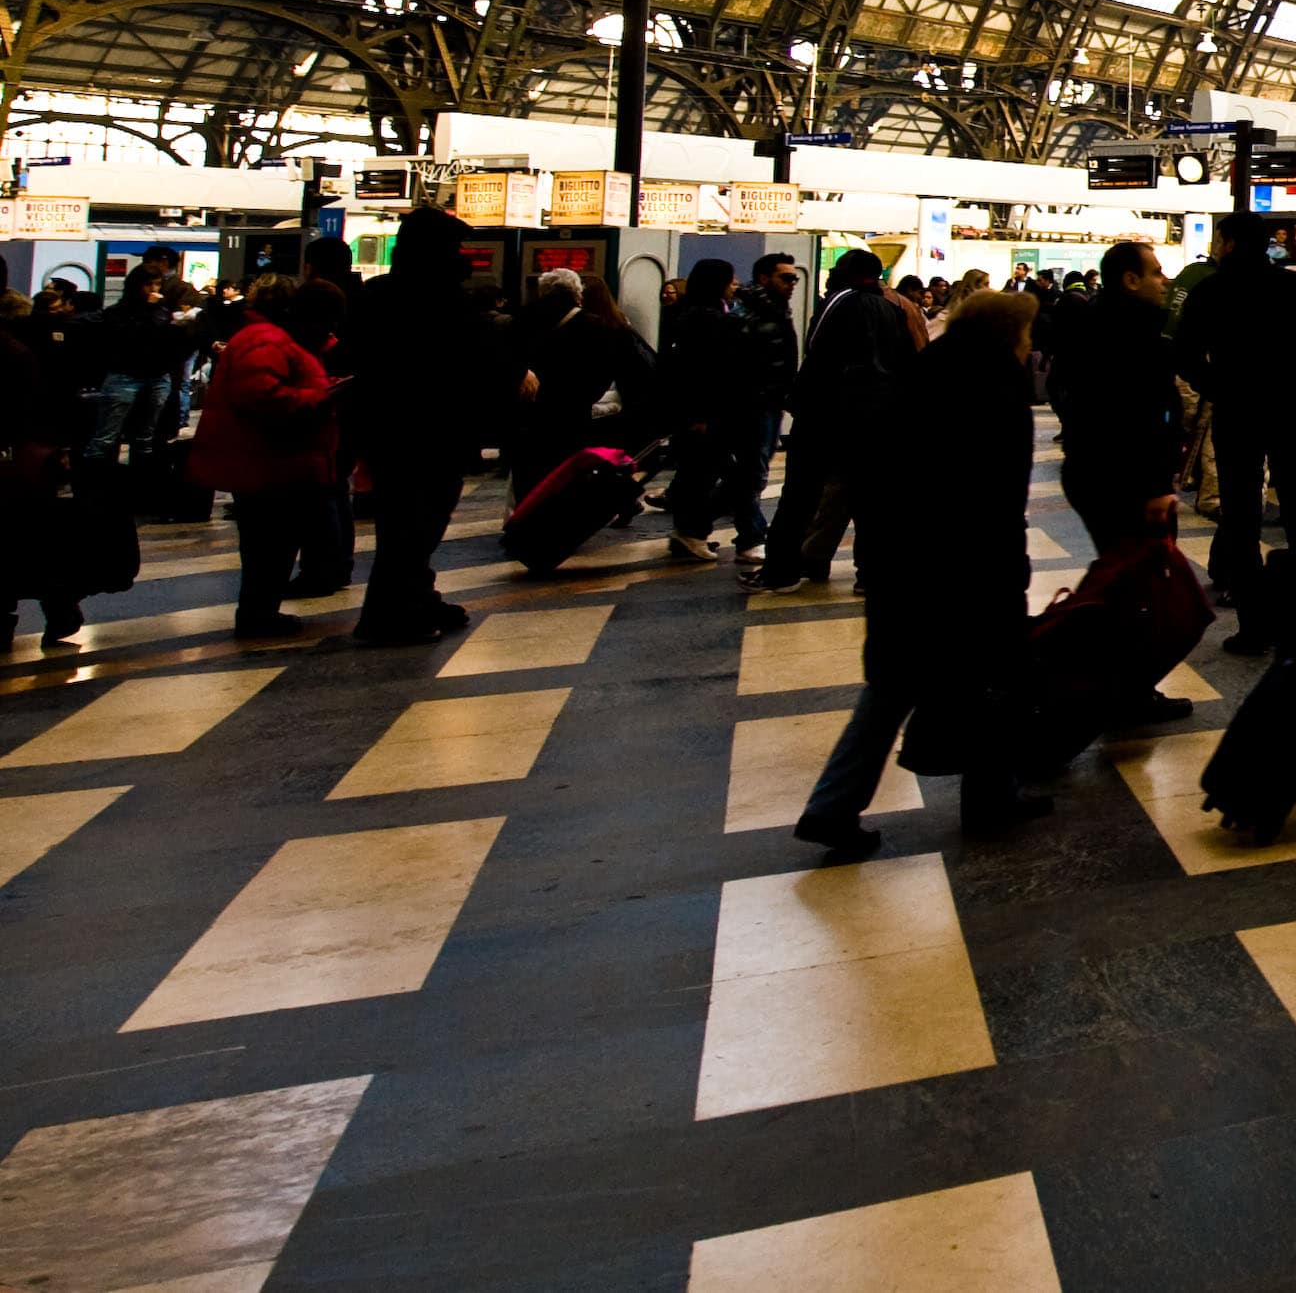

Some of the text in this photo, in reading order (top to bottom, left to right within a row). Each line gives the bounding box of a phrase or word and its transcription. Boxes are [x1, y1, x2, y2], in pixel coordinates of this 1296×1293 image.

[463, 181, 503, 193] BIGLIETTO
[558, 180, 600, 192] BIGLIETTO
[464, 193, 493, 203] VELOCE
[559, 192, 589, 203] VELOCE
[639, 192, 693, 203] BIGLIETTO
[739, 190, 792, 201] BIGLIETTO
[25, 203, 81, 213] BIGLIETTO
[639, 202, 678, 212] VELOCE
[740, 201, 778, 211] VELOCE
[25, 213, 66, 222] VELOCE
[325, 217, 338, 232] 11
[226, 235, 240, 249] 11
